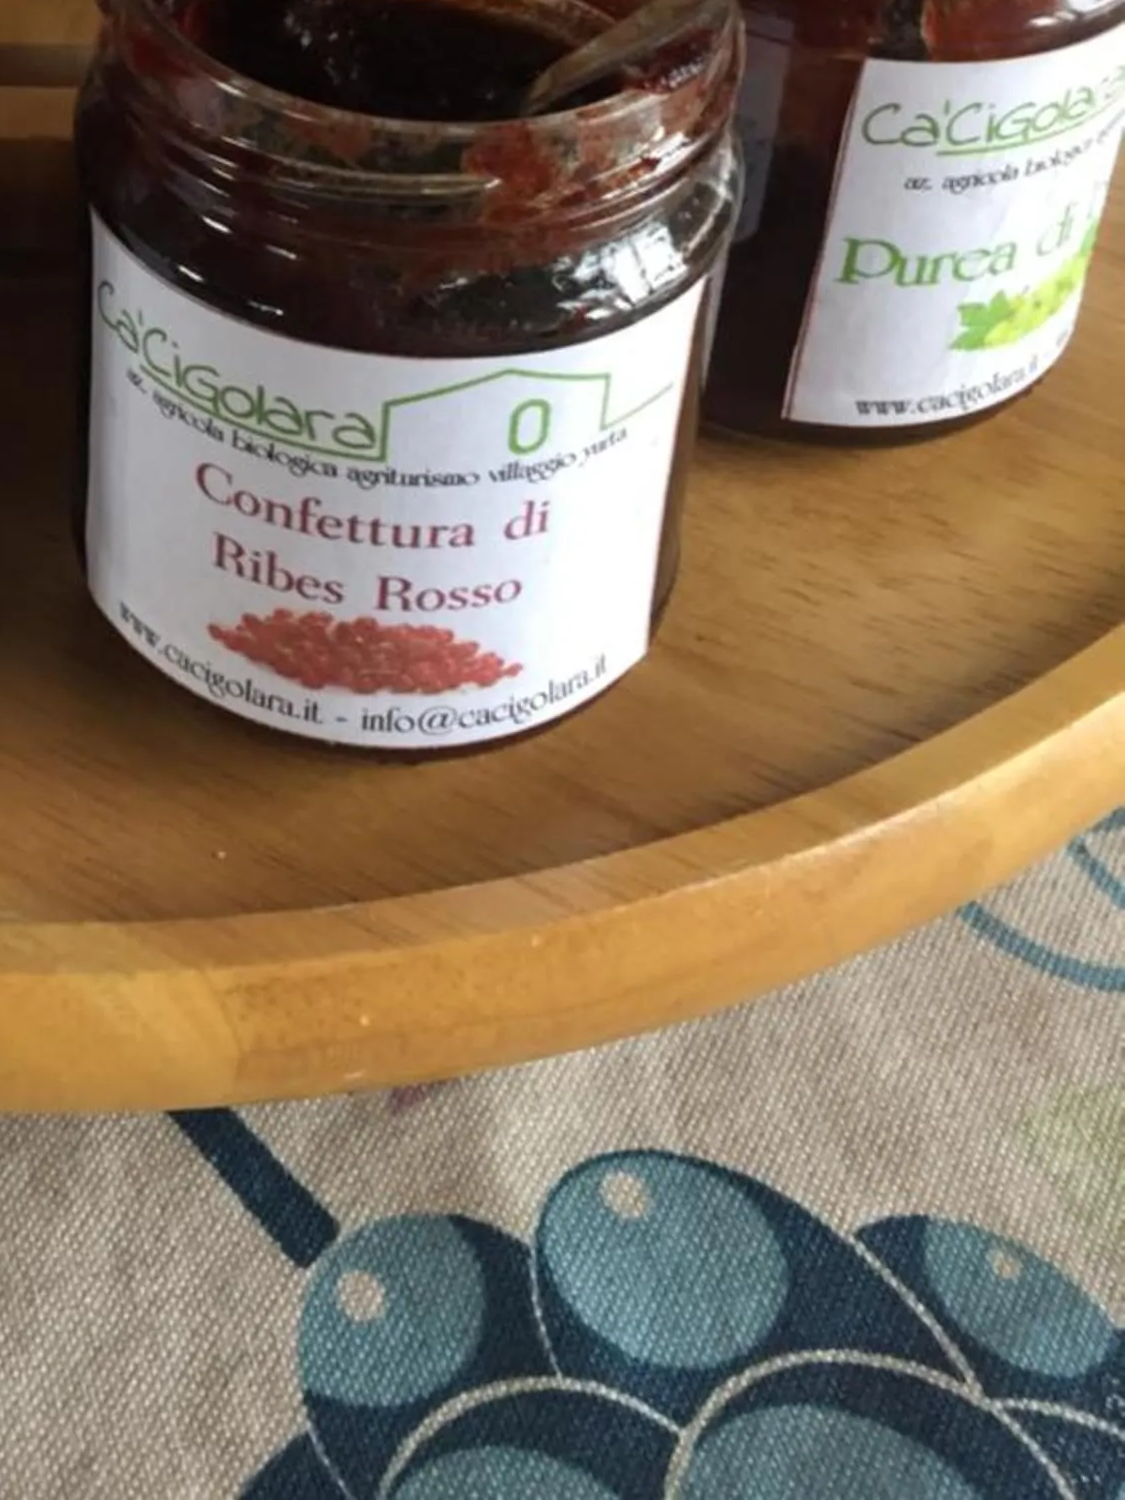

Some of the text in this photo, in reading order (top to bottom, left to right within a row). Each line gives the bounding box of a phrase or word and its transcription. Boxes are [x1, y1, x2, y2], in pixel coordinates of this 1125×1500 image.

[833, 235, 1018, 288] Purea
[151, 389, 225, 443] agricola
[231, 428, 339, 479] biologica
[346, 459, 481, 490] agriturismo
[488, 450, 577, 485] villaggio
[193, 461, 552, 550] Confettura di
[212, 530, 524, 613] Ribes Rosso
[118, 601, 324, 725] www.cacigolara.it
[360, 651, 609, 736] info@cacigolara.it
